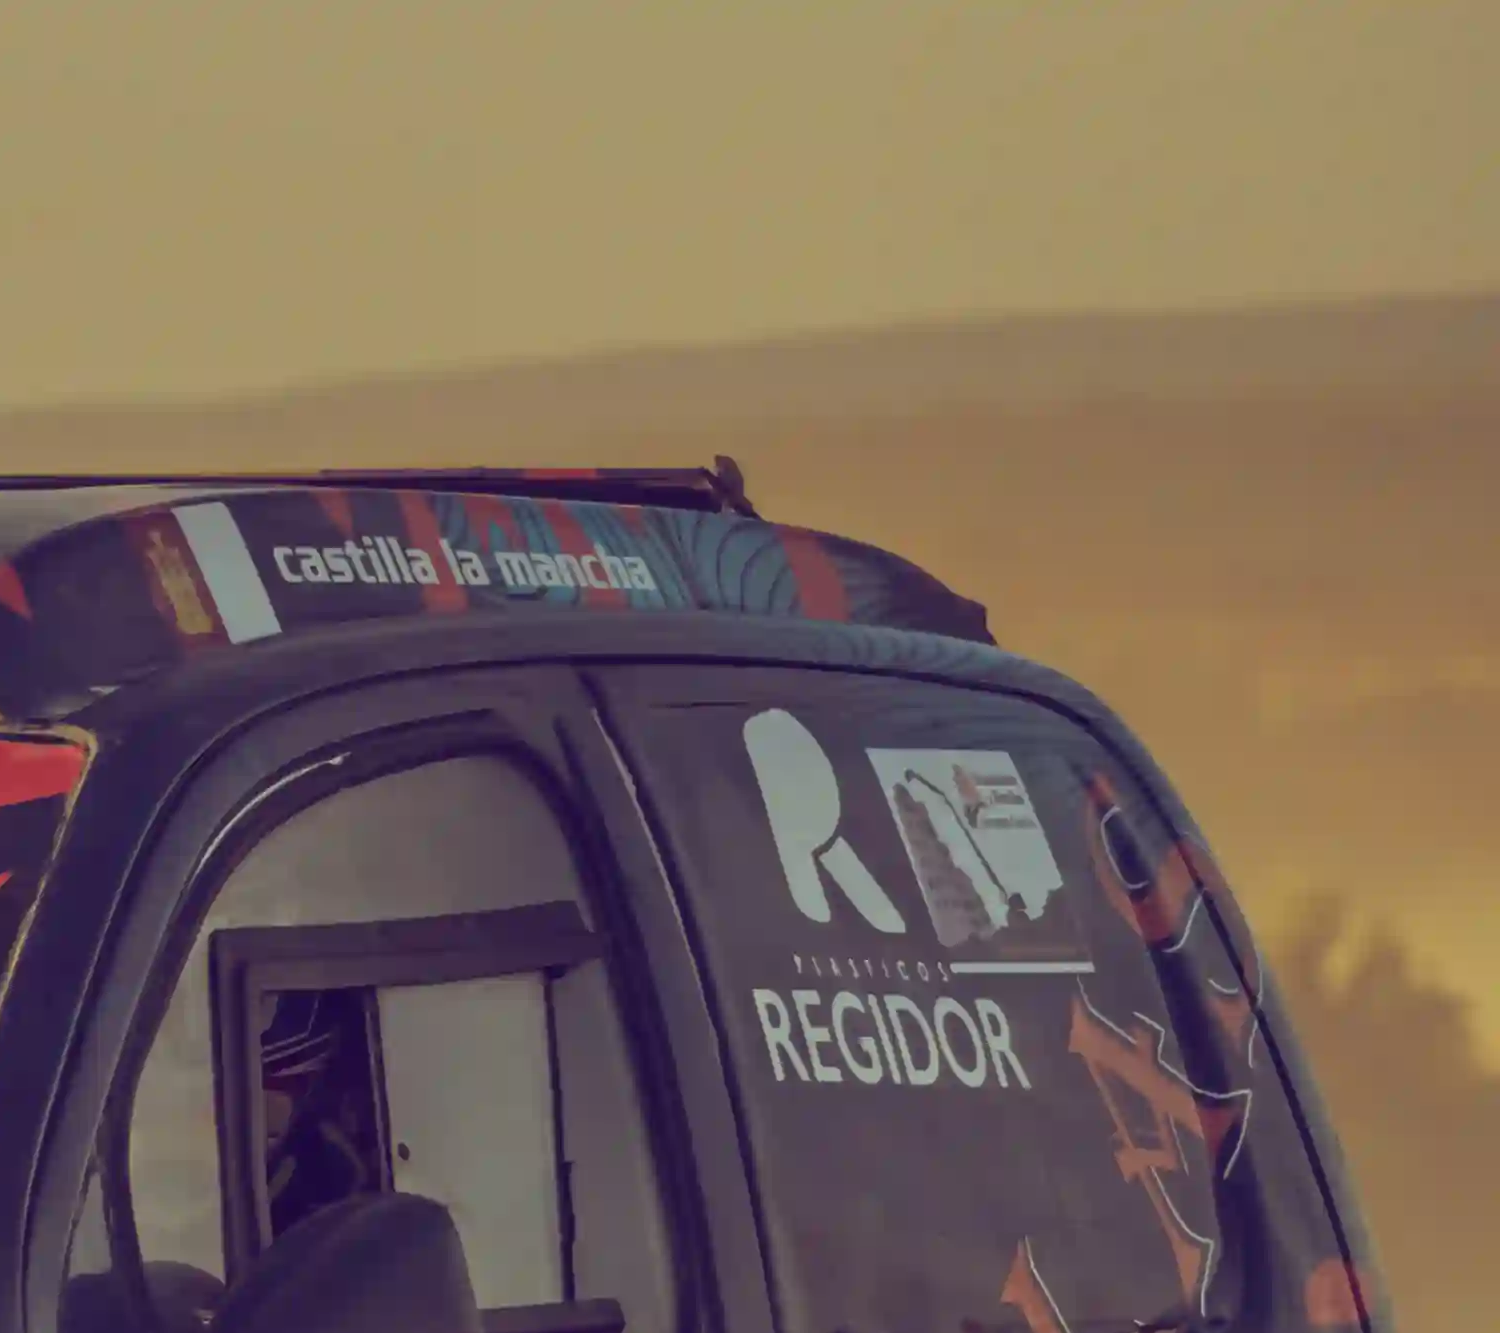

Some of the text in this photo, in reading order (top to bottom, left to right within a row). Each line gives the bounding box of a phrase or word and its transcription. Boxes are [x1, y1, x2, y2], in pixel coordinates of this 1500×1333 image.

[273, 533, 657, 593] castilla la mancha
[752, 986, 1032, 1091] REGIDOR
